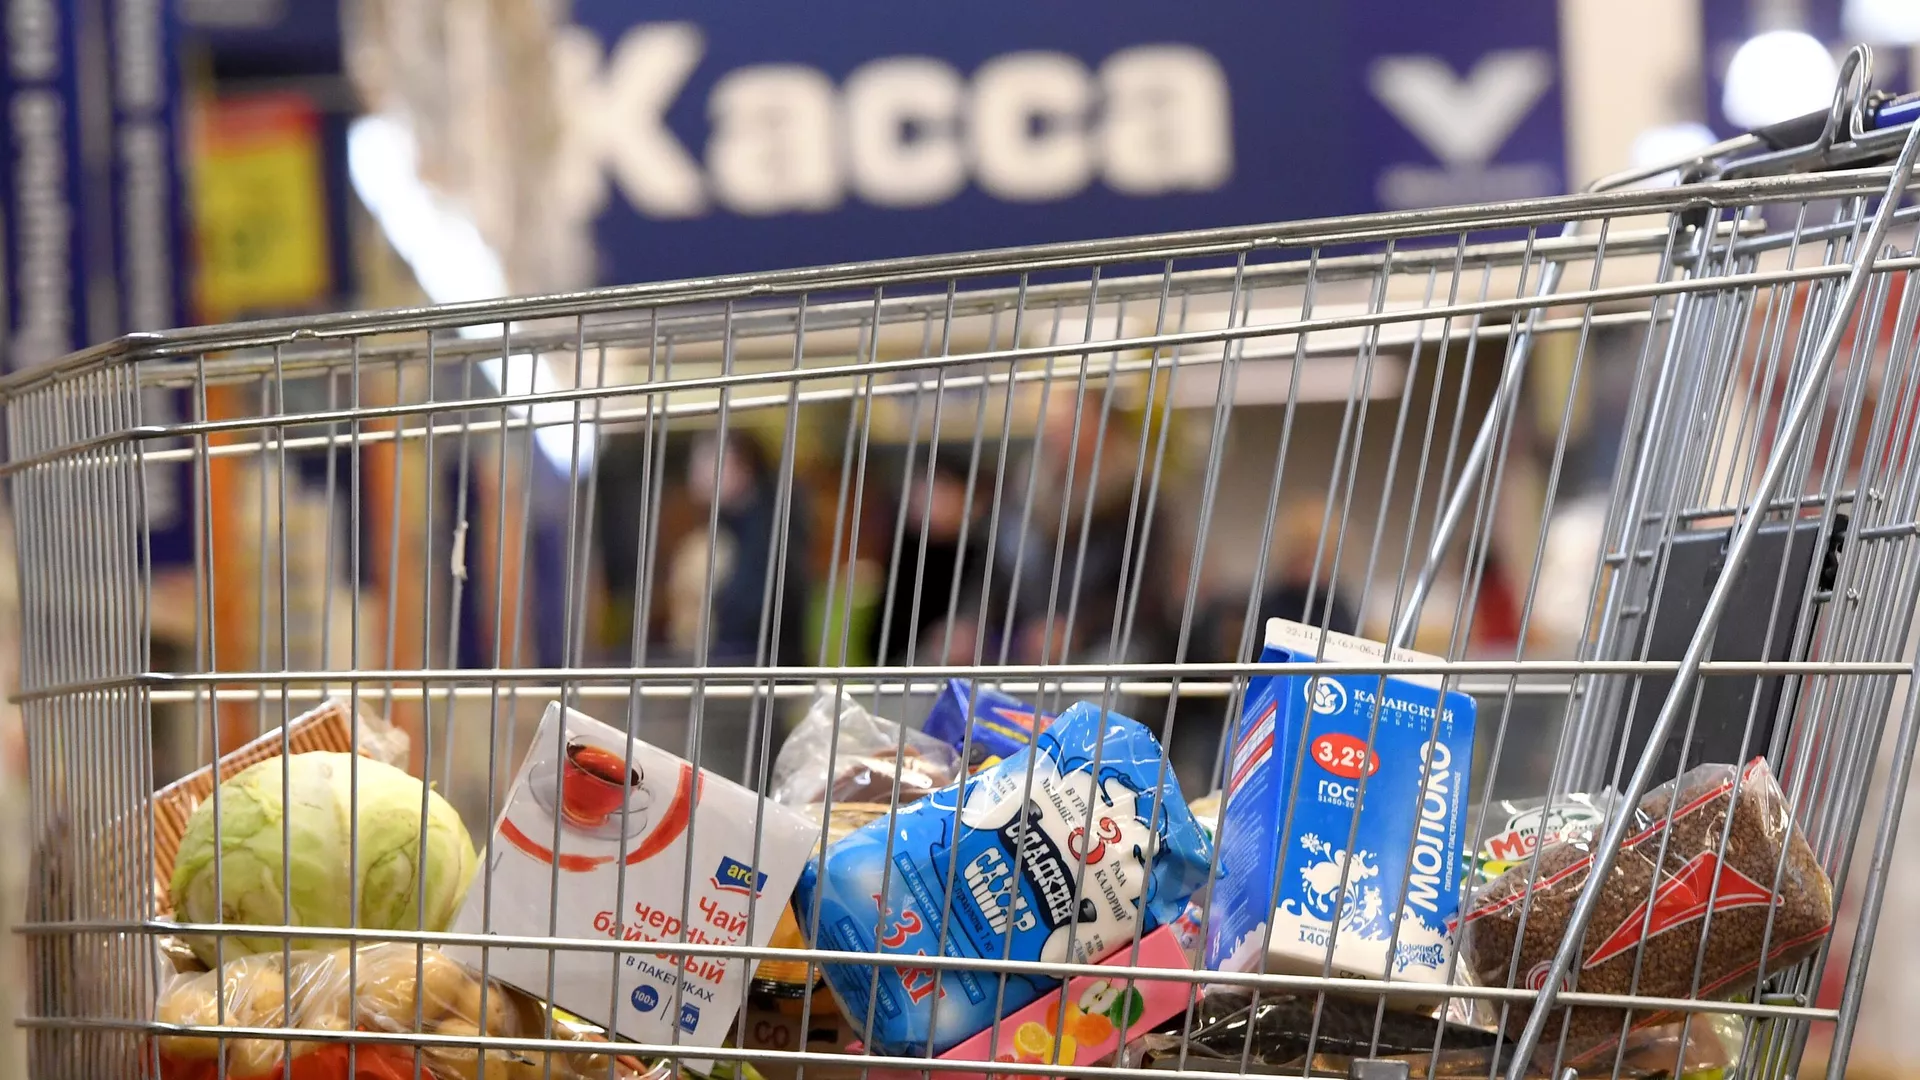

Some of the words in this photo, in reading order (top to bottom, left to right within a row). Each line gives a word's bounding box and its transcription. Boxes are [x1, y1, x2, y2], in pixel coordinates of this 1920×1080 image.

[550, 22, 1233, 218] Касса
[1354, 701, 1452, 731] МОЛОЧНЙ
[1354, 709, 1452, 738] КОМБИНТ
[1318, 741, 1374, 773] 3,2%
[1317, 794, 1364, 811] 31450-20
[1408, 740, 1451, 913] МОЛОКО
[727, 864, 754, 884] aro
[1004, 819, 1075, 925] СЛАДКИЙ
[1110, 860, 1129, 888] РАЗА
[963, 847, 1037, 935] САХАР
[699, 897, 749, 937] Чай
[626, 956, 634, 966] В
